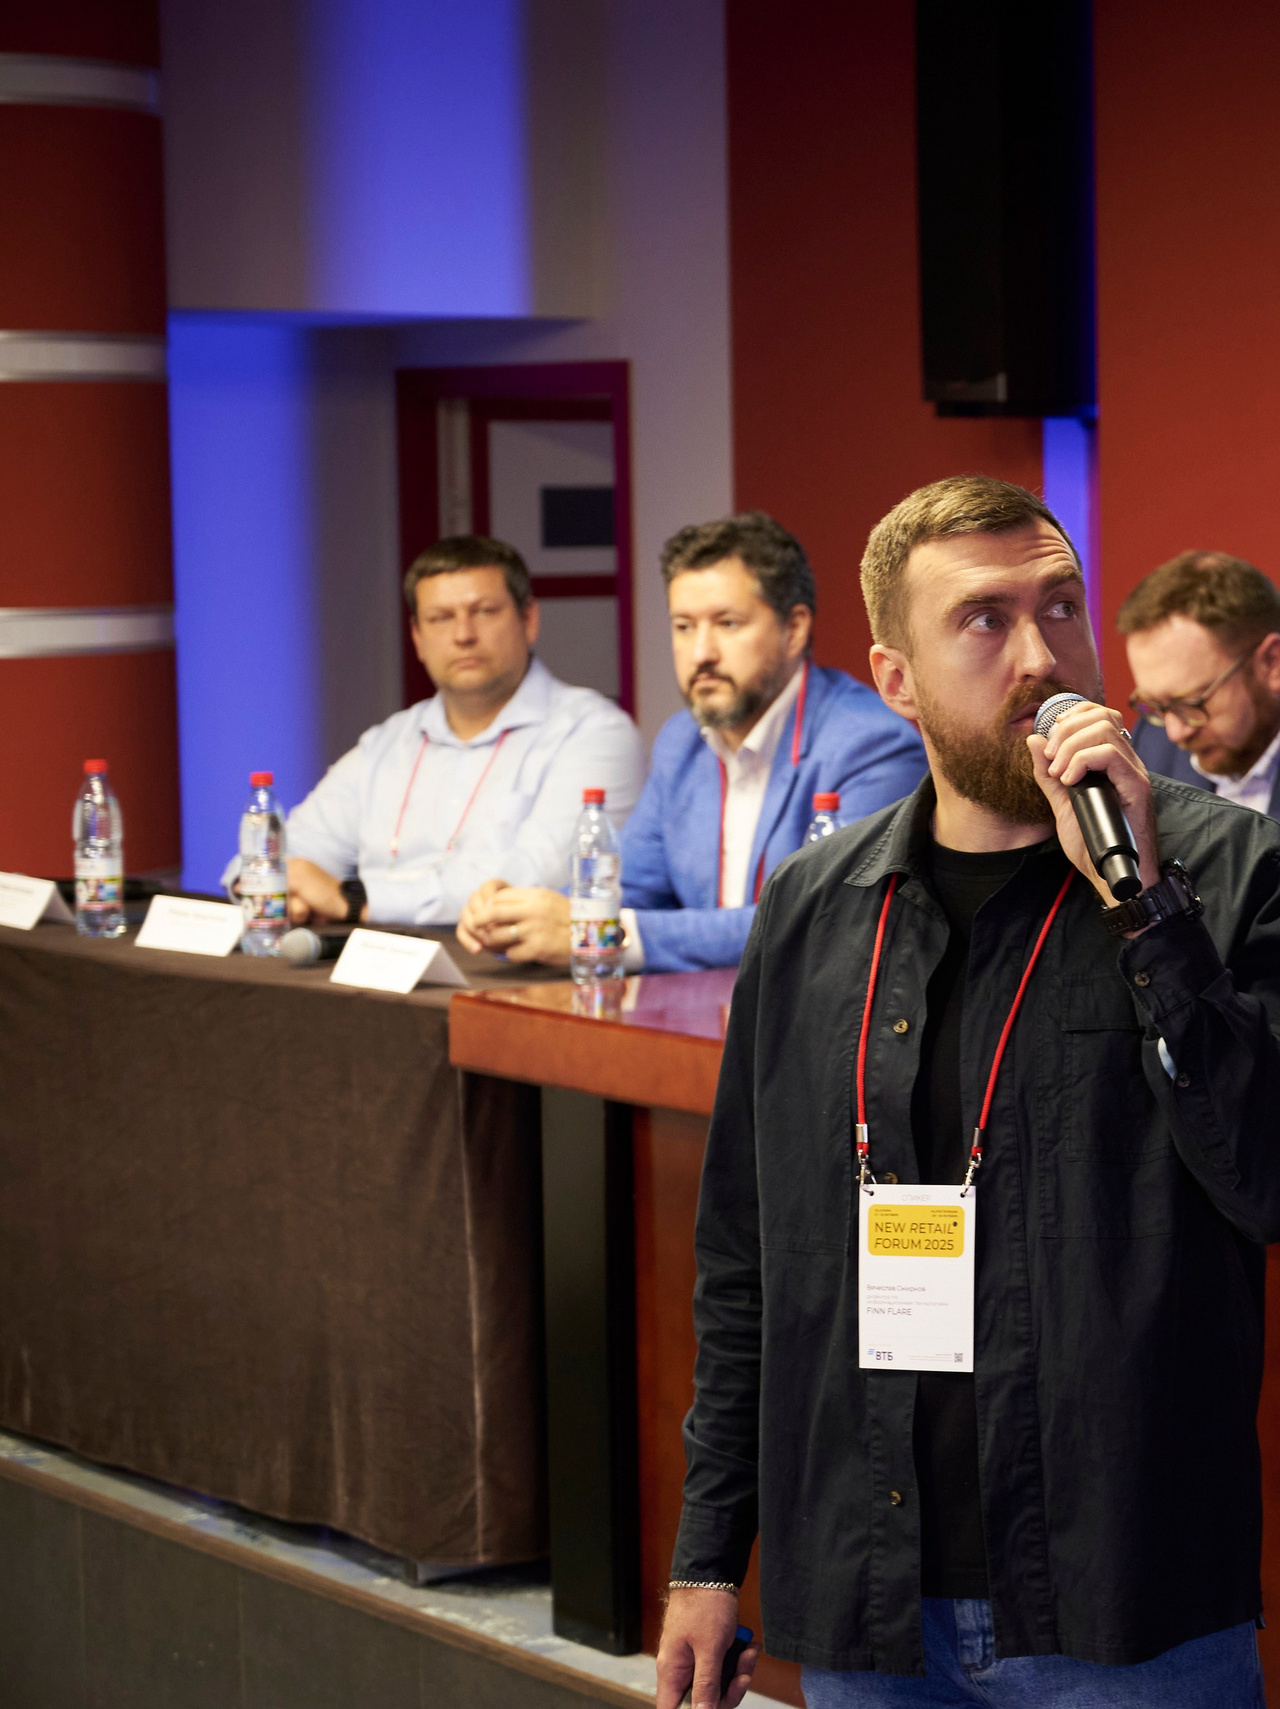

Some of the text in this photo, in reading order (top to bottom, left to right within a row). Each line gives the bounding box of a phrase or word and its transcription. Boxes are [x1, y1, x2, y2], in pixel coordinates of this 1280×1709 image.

[874, 1221, 954, 1235] NEW RETAIL
[874, 1237, 955, 1251] FORUM 2025
[867, 1306, 912, 1316] FINN FLARE
[875, 1350, 894, 1361] ВТБ
